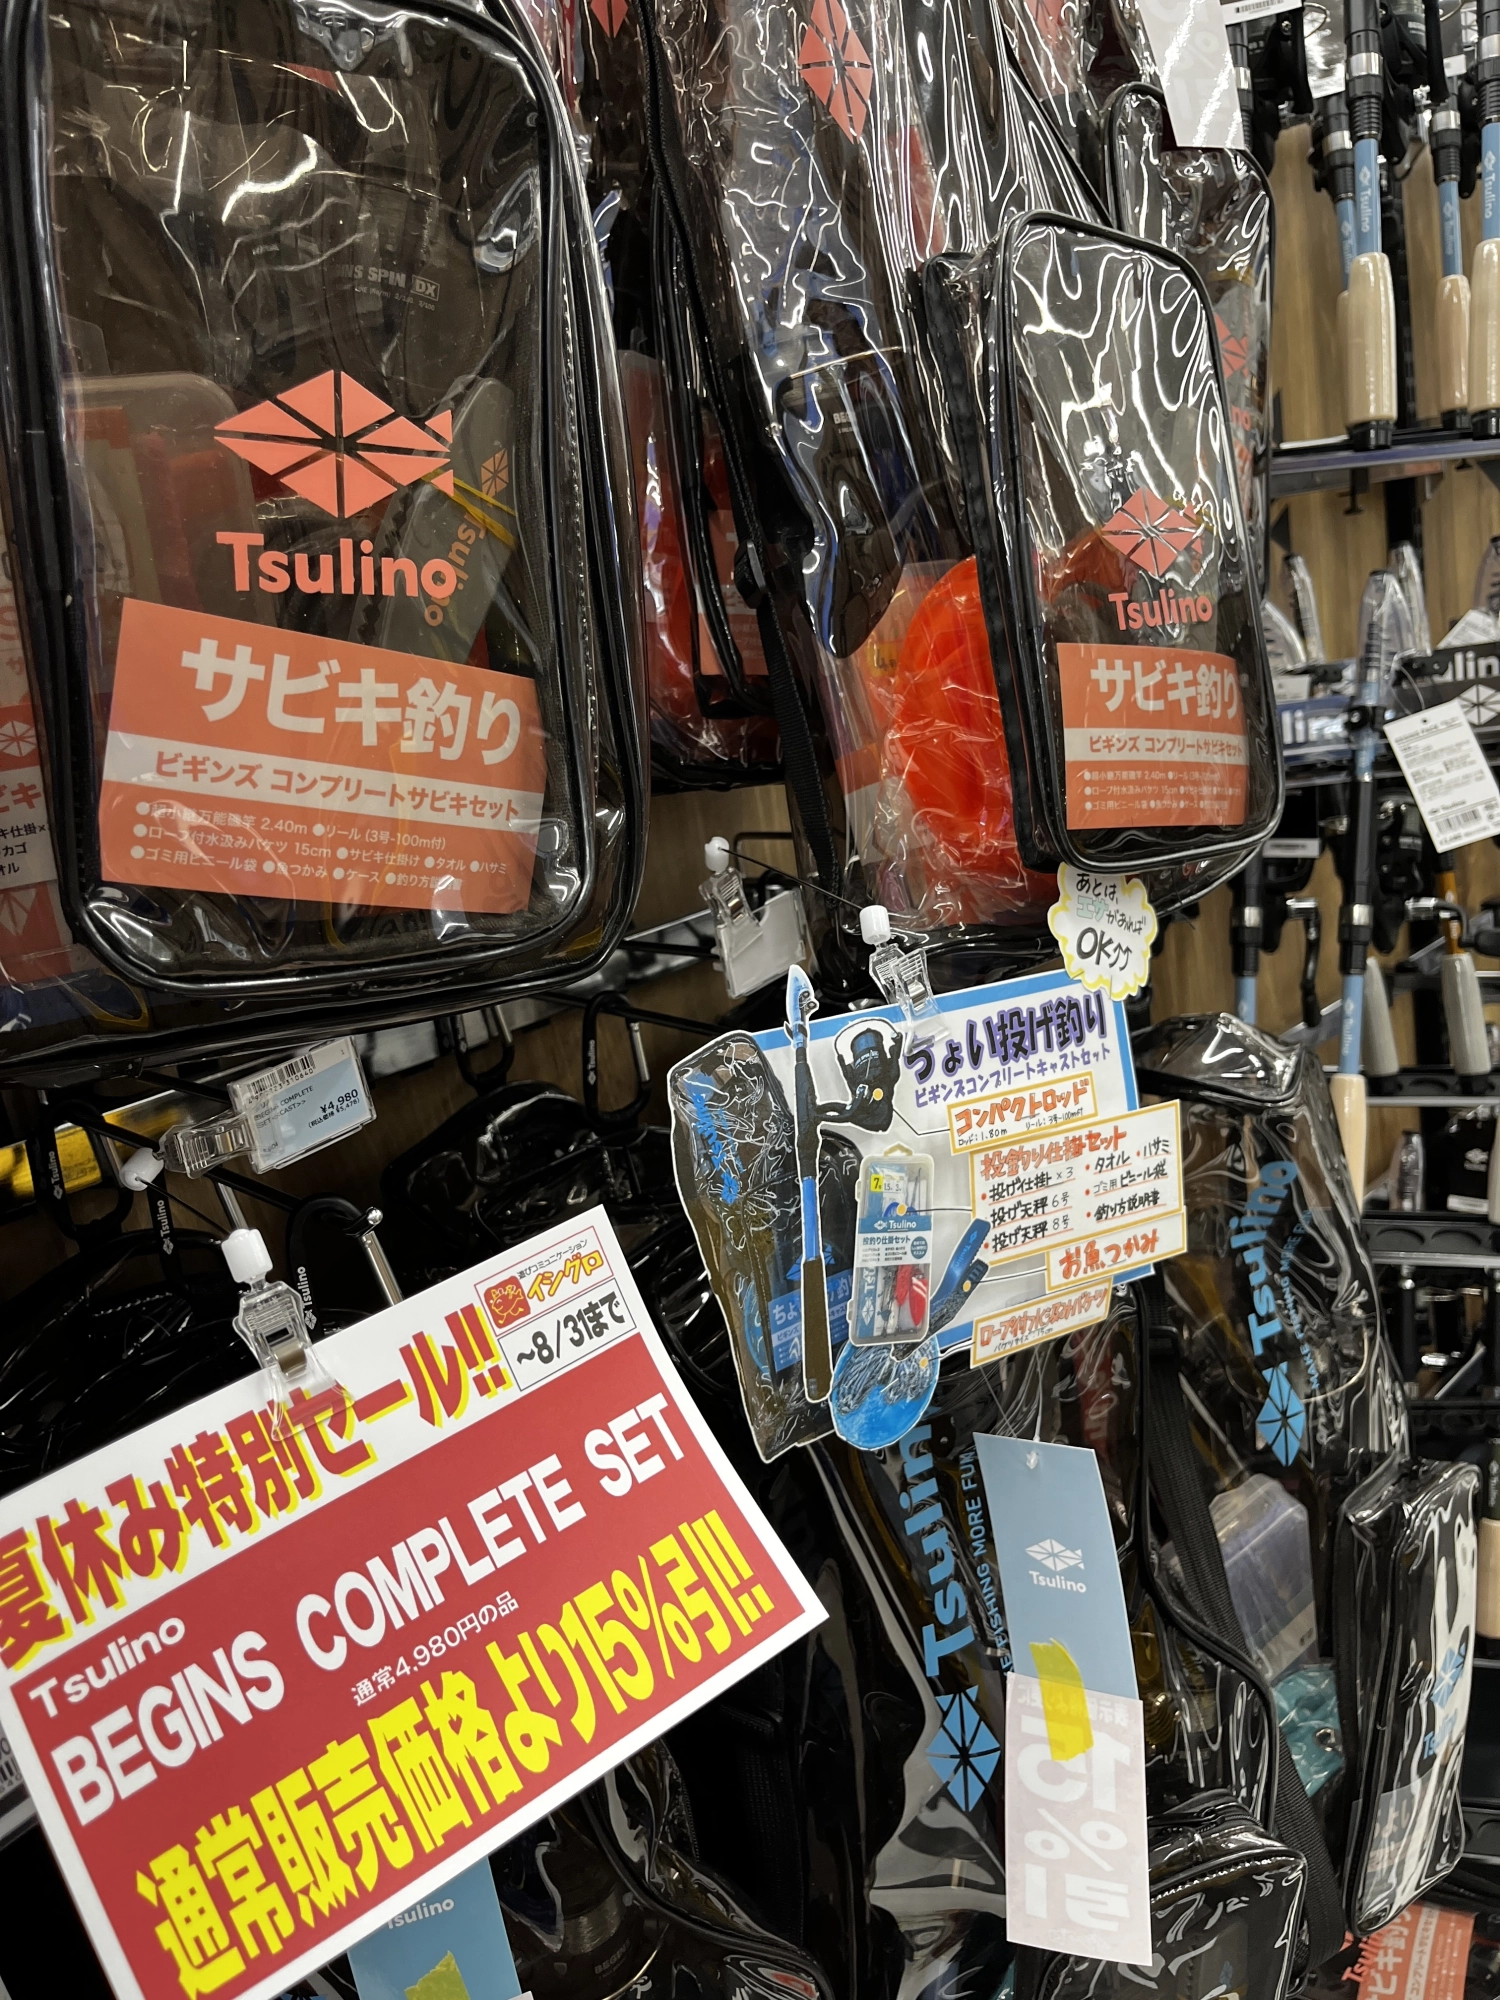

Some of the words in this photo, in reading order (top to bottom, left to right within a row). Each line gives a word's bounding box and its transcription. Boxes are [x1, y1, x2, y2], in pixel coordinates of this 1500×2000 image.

[1485, 173, 1496, 219] Tsulino
[368, 266, 406, 288] SPIN
[415, 279, 437, 298] DX
[216, 531, 457, 598] Tsulino
[1108, 588, 1214, 631] Tsulino
[180, 637, 521, 766] サビキ釣り
[1090, 658, 1239, 720] サビキ釣り
[1089, 734, 1140, 754] ビギンズ
[155, 750, 259, 789] ビギンズ
[270, 766, 519, 822] コンプリートサビキセット
[1144, 771, 1166, 780] 2.40m
[1161, 786, 1179, 795] 15cm
[148, 827, 288, 853] ロープ付水汲みバケツ
[294, 842, 332, 858] 15cm
[350, 849, 420, 867] サビキ仕掛け
[435, 857, 466, 872] タオル
[479, 862, 507, 875] ハサミ
[260, 817, 308, 835] 2.40m
[326, 824, 361, 841] リール
[365, 829, 446, 850] (3号-100m付)
[145, 847, 258, 873] ゴミ用ビニール袋
[275, 862, 327, 879] 魚つかみ
[346, 870, 380, 883] ケース
[1076, 894, 1147, 936] エサがあれば
[1076, 926, 1115, 966] OK
[904, 990, 1107, 1084] ちょい投げ釣り
[279, 1085, 315, 1107] COMPLETE
[320, 1088, 359, 1114] ¥4,980
[955, 1078, 1090, 1136] コンパクトロッド
[980, 1125, 1127, 1181] 投釣り仕掛セット
[1094, 1151, 1131, 1174] タオル
[1143, 1136, 1170, 1156] ハサミ
[49, 1151, 62, 1185] Tsulino
[156, 1199, 171, 1237] Tsulino
[889, 1219, 917, 1230] Tsulino
[1094, 1188, 1160, 1222] 釣り方説明書
[517, 1239, 588, 1280] 遊びコミュニケーション
[527, 1249, 605, 1302] イシグロ
[1059, 1228, 1160, 1280] お魚つかみ
[1228, 1160, 1299, 1357] Tsulino
[297, 1266, 313, 1311] Tsulino
[1299, 1343, 1321, 1390] MAKE
[965, 1497, 987, 1556] MORE
[900, 1422, 976, 1678] Tsulin
[1029, 1569, 1087, 1594] Tsulino
[50, 1630, 285, 1827] BEGINS
[296, 1453, 587, 1672] COMPLETE
[584, 1392, 684, 1497] SET
[29, 1617, 186, 1718] Tsulino
